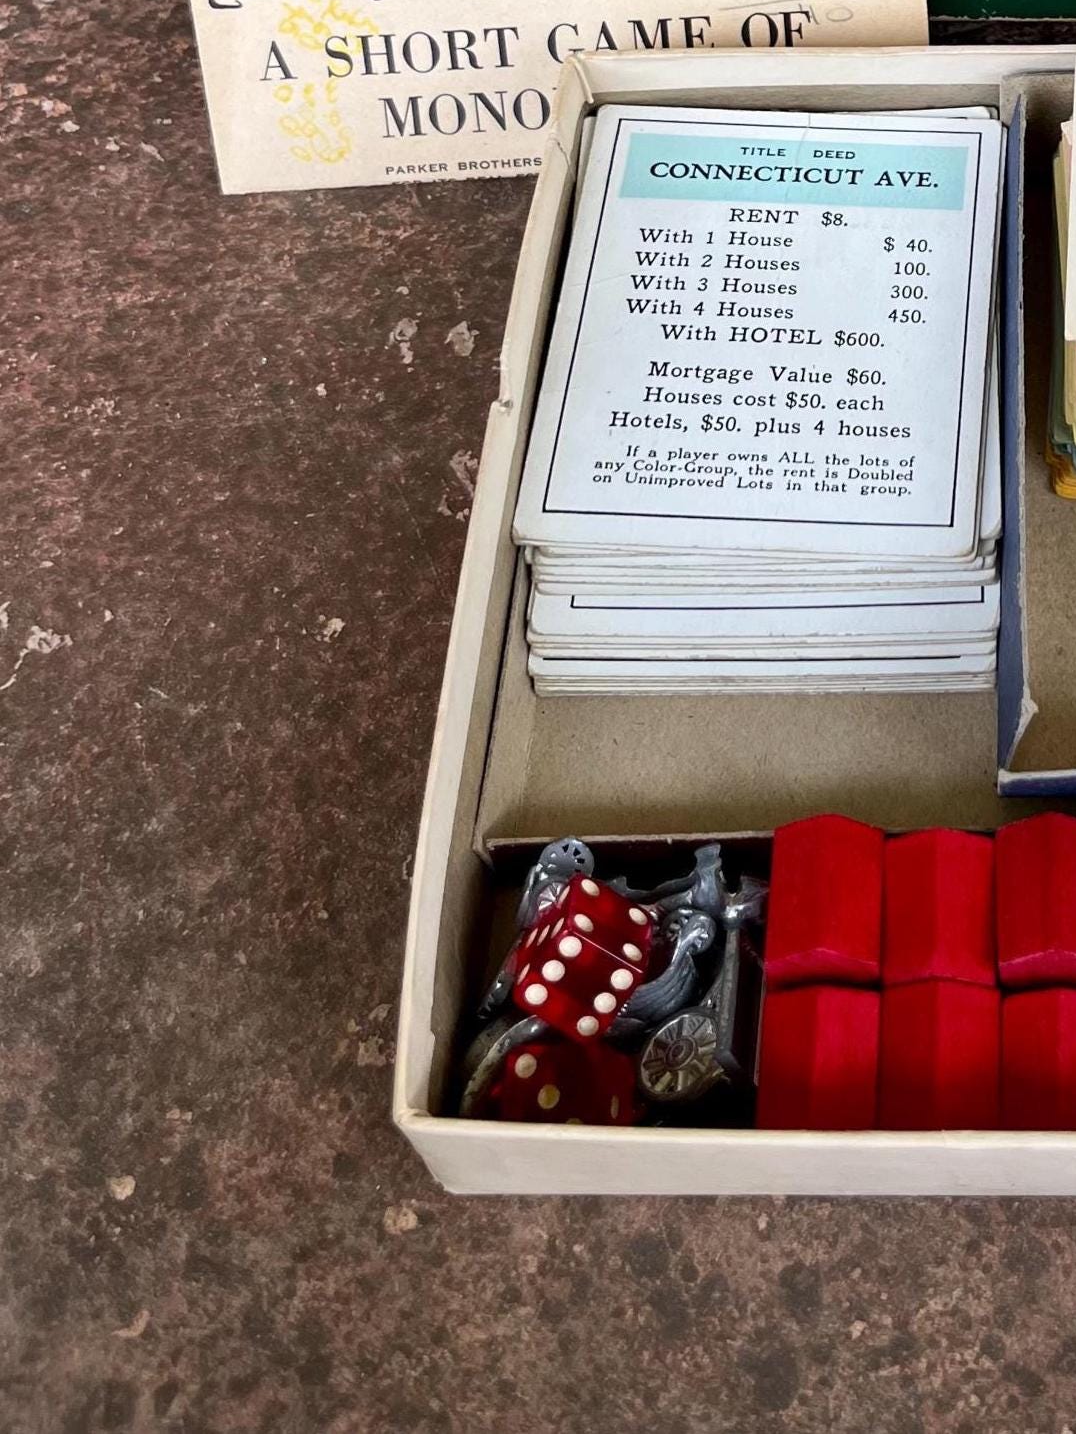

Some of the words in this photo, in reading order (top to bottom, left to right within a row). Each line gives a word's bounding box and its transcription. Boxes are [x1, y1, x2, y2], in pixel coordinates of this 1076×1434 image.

[259, 40, 298, 81] A
[324, 26, 519, 78] SHORT
[740, 9, 812, 51] OF
[378, 87, 550, 138] MONO
[384, 162, 450, 176] PARKER
[457, 156, 543, 172] BROTHERS
[740, 146, 787, 158] TITLE
[812, 149, 856, 161] DEED
[648, 161, 864, 187] CONNECTICUT
[873, 169, 942, 189] AVE.
[728, 207, 800, 226] RENT
[820, 210, 849, 228] $8.
[638, 227, 695, 246] With
[706, 230, 716, 245] 1
[728, 230, 794, 249] House
[634, 251, 691, 269] With
[700, 254, 713, 269] 2
[723, 254, 801, 272] Houses
[893, 261, 932, 278] 100.
[629, 274, 687, 294] With
[697, 277, 709, 293] 3
[721, 277, 799, 296] Houses
[889, 284, 930, 301] 300.
[625, 298, 684, 319] With
[692, 301, 706, 318] 4
[716, 301, 795, 320] Houses
[886, 308, 928, 326] 450.
[660, 323, 718, 343] With
[728, 326, 823, 346] HOTEL
[833, 330, 887, 349] $600.
[647, 361, 755, 386] Mortgage
[768, 366, 834, 386] Value
[846, 367, 888, 387] $60.
[642, 387, 724, 408] Houses
[731, 391, 778, 410] cost
[785, 391, 829, 411] $50.
[835, 394, 886, 412] each
[608, 410, 690, 434] Hotels,
[700, 414, 743, 434] $50.
[753, 416, 802, 438] plus
[812, 420, 826, 436] 4
[838, 419, 913, 440] houses
[625, 444, 641, 458] If
[647, 448, 658, 459] a
[667, 446, 720, 464] player
[727, 454, 769, 463] owns
[777, 449, 816, 465] ALL
[824, 451, 852, 466] the
[859, 452, 892, 467] lots
[898, 453, 916, 467] of
[594, 459, 625, 474] any
[633, 458, 738, 479] Color-Group,
[747, 462, 777, 476] the
[782, 466, 818, 478] rent
[824, 466, 839, 479] is
[846, 466, 915, 482] Doubled
[592, 476, 613, 485] on
[624, 472, 725, 491] Unimproved
[735, 476, 775, 490] Lots
[784, 480, 803, 491] in
[812, 478, 850, 493] that
[858, 483, 913, 497] group.
